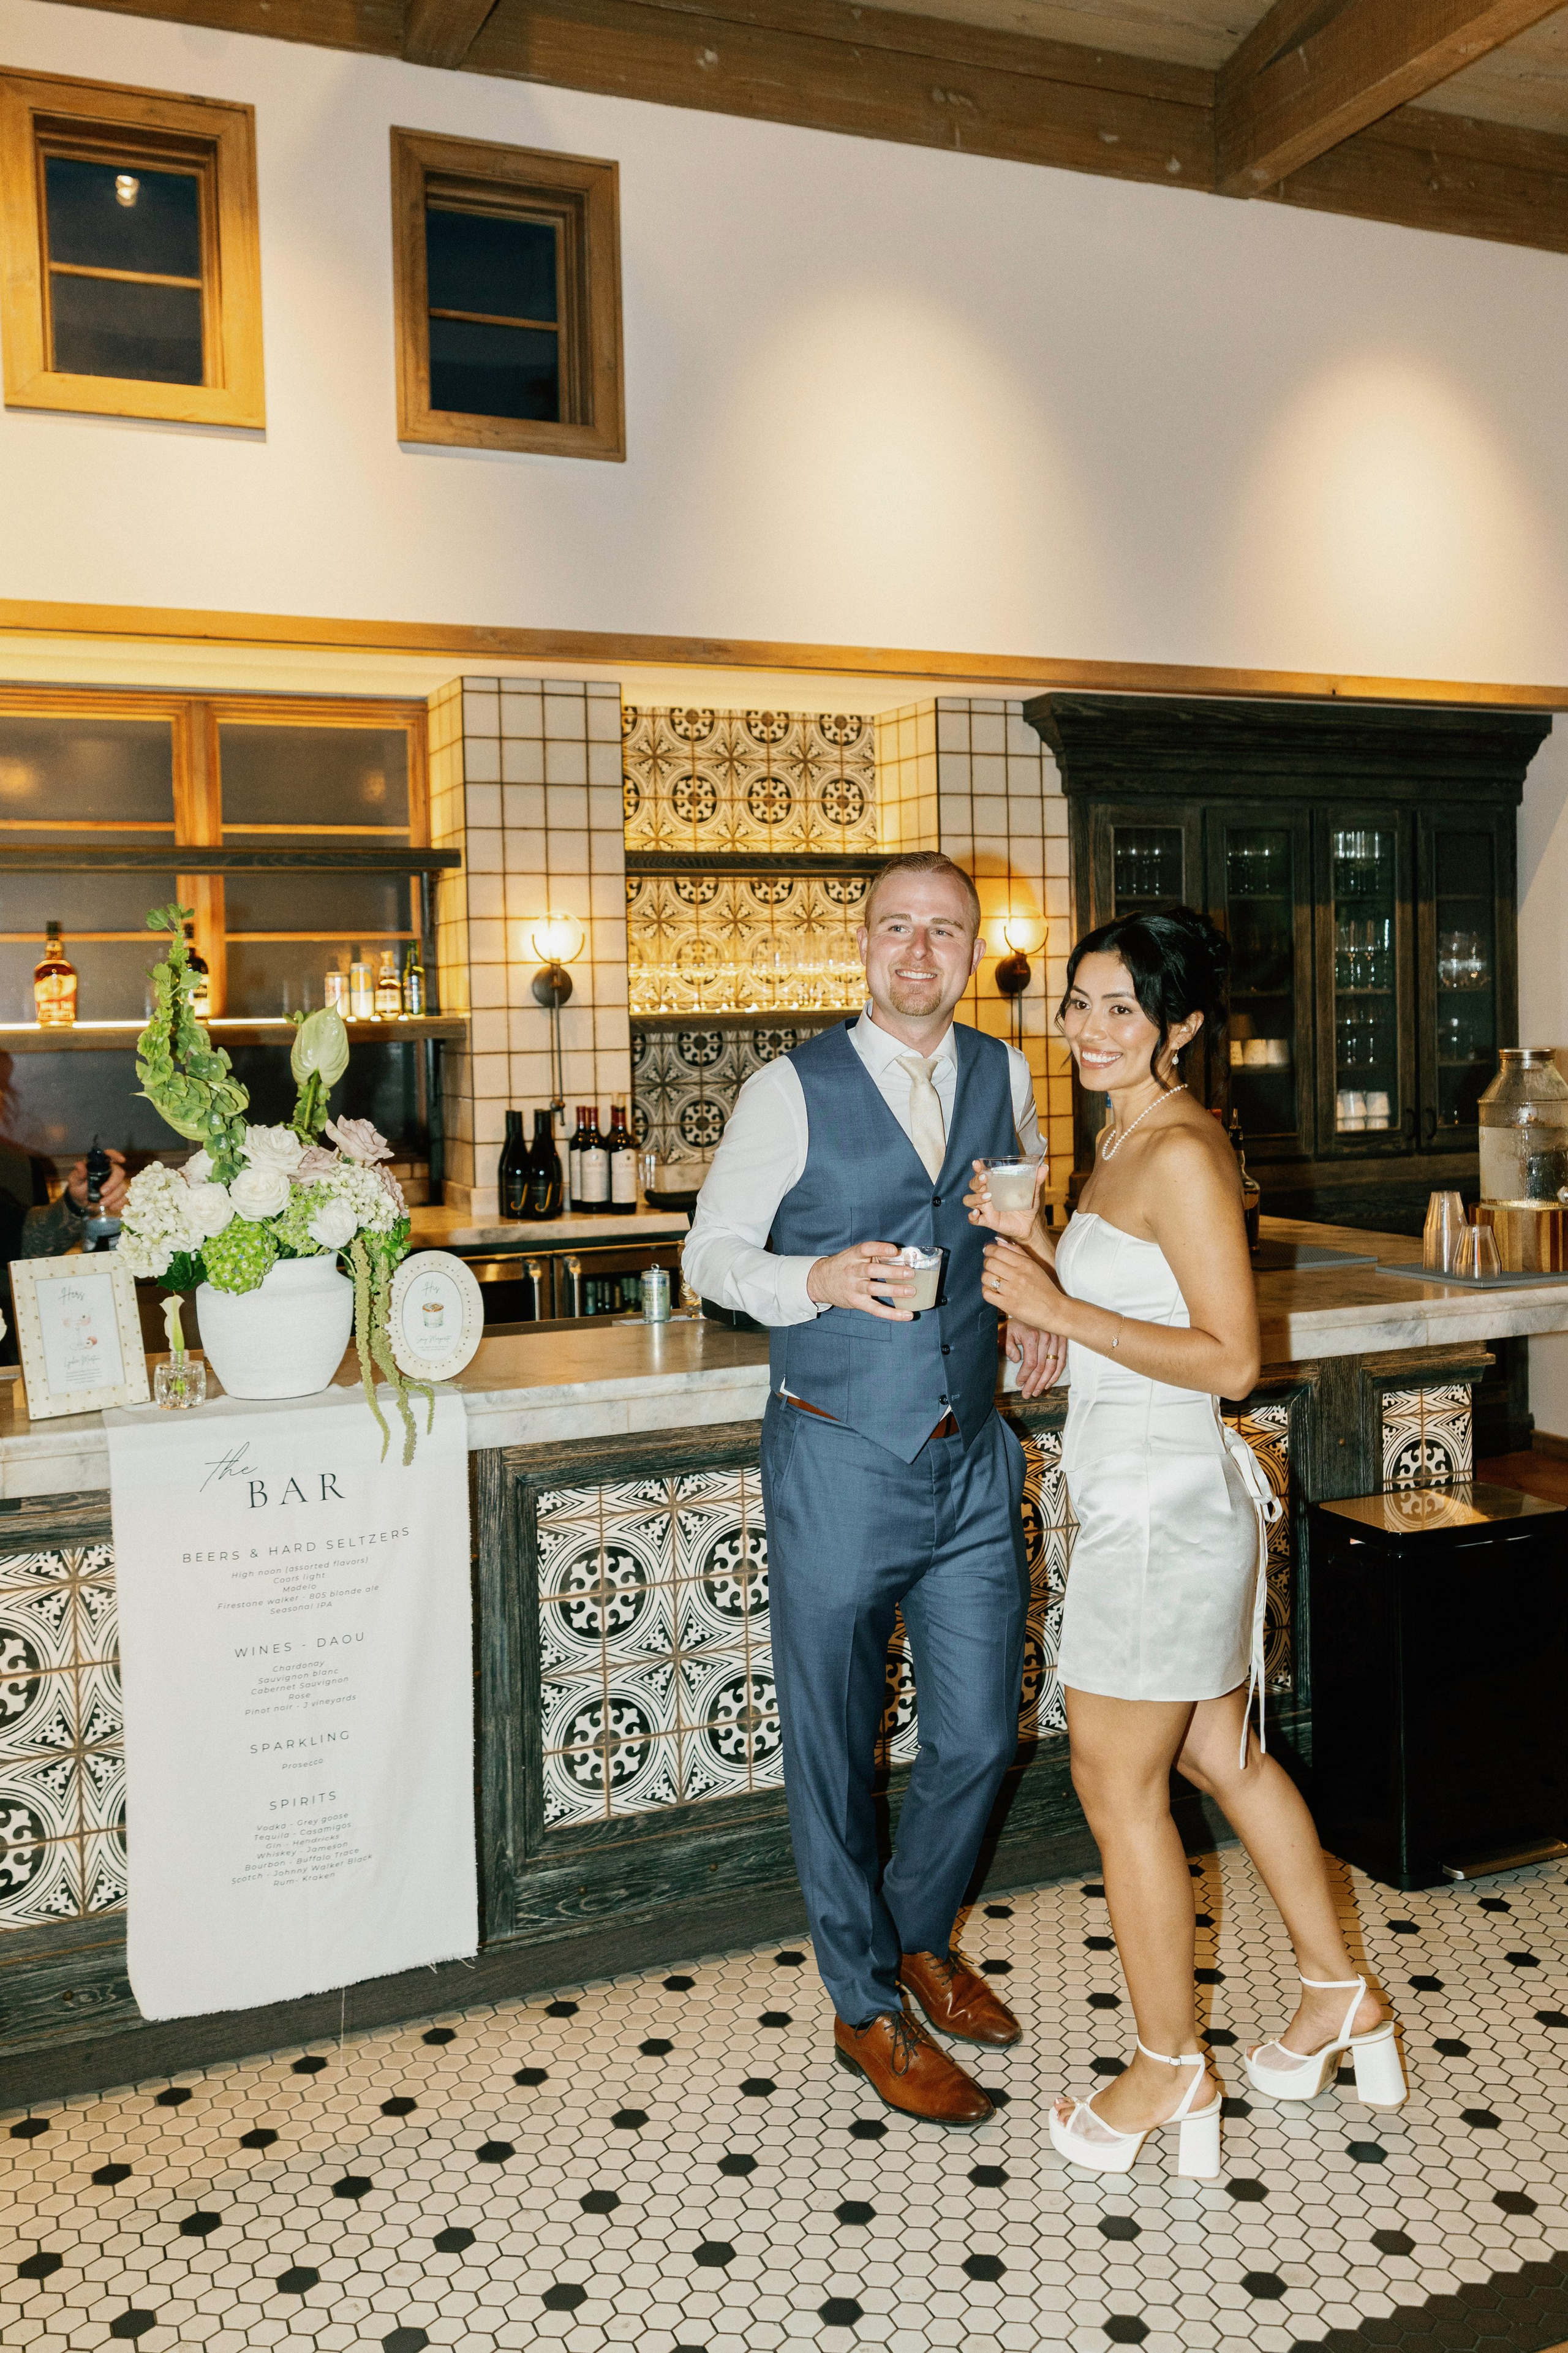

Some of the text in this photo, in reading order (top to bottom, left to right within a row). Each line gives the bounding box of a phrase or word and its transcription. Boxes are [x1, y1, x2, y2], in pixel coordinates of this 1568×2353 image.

[421, 1280, 440, 1296] His
[199, 1441, 258, 1492] the
[246, 1473, 347, 1509] BAR
[183, 1527, 409, 1563] BEERS & HARD SELTZERS
[258, 1568, 282, 1576] noon
[285, 1562, 330, 1574] (assorted
[333, 1557, 368, 1567] flavors)
[273, 1572, 325, 1584] Coors light
[283, 1584, 317, 1593] Modelo
[217, 1600, 263, 1610] Firestone
[267, 1595, 299, 1605] walker
[330, 1587, 361, 1597] blonde
[270, 1603, 314, 1614] Seasonal
[234, 1642, 292, 1658] WINES
[317, 1632, 364, 1648] DAOU
[273, 1660, 325, 1672] Chardonay
[251, 1677, 349, 1695] Cabernet Sauvignon
[258, 1668, 339, 1685] Sauvignon blanc
[311, 1694, 356, 1707] vineyards
[250, 1730, 349, 1754] SPARKLING
[282, 1758, 323, 1770] Prosecco
[270, 1791, 336, 1811] SPIRITS
[254, 1832, 290, 1841] Tequila
[300, 1822, 352, 1836] Casamigos
[256, 1823, 287, 1832] Vodka
[321, 1813, 349, 1824] goose
[293, 1834, 340, 1846] Hendricks
[244, 1860, 285, 1871] Bourbon
[296, 1854, 331, 1865] Buffalo
[334, 1848, 360, 1858] Trace
[257, 1849, 297, 1860] Whiskey
[307, 1841, 349, 1853] Jameson
[231, 1873, 263, 1885] Scotch
[273, 1867, 308, 1877] Johnny
[312, 1860, 344, 1871] Walker
[347, 1853, 373, 1865] Black
[273, 1871, 336, 1887] Rum- Kraken
